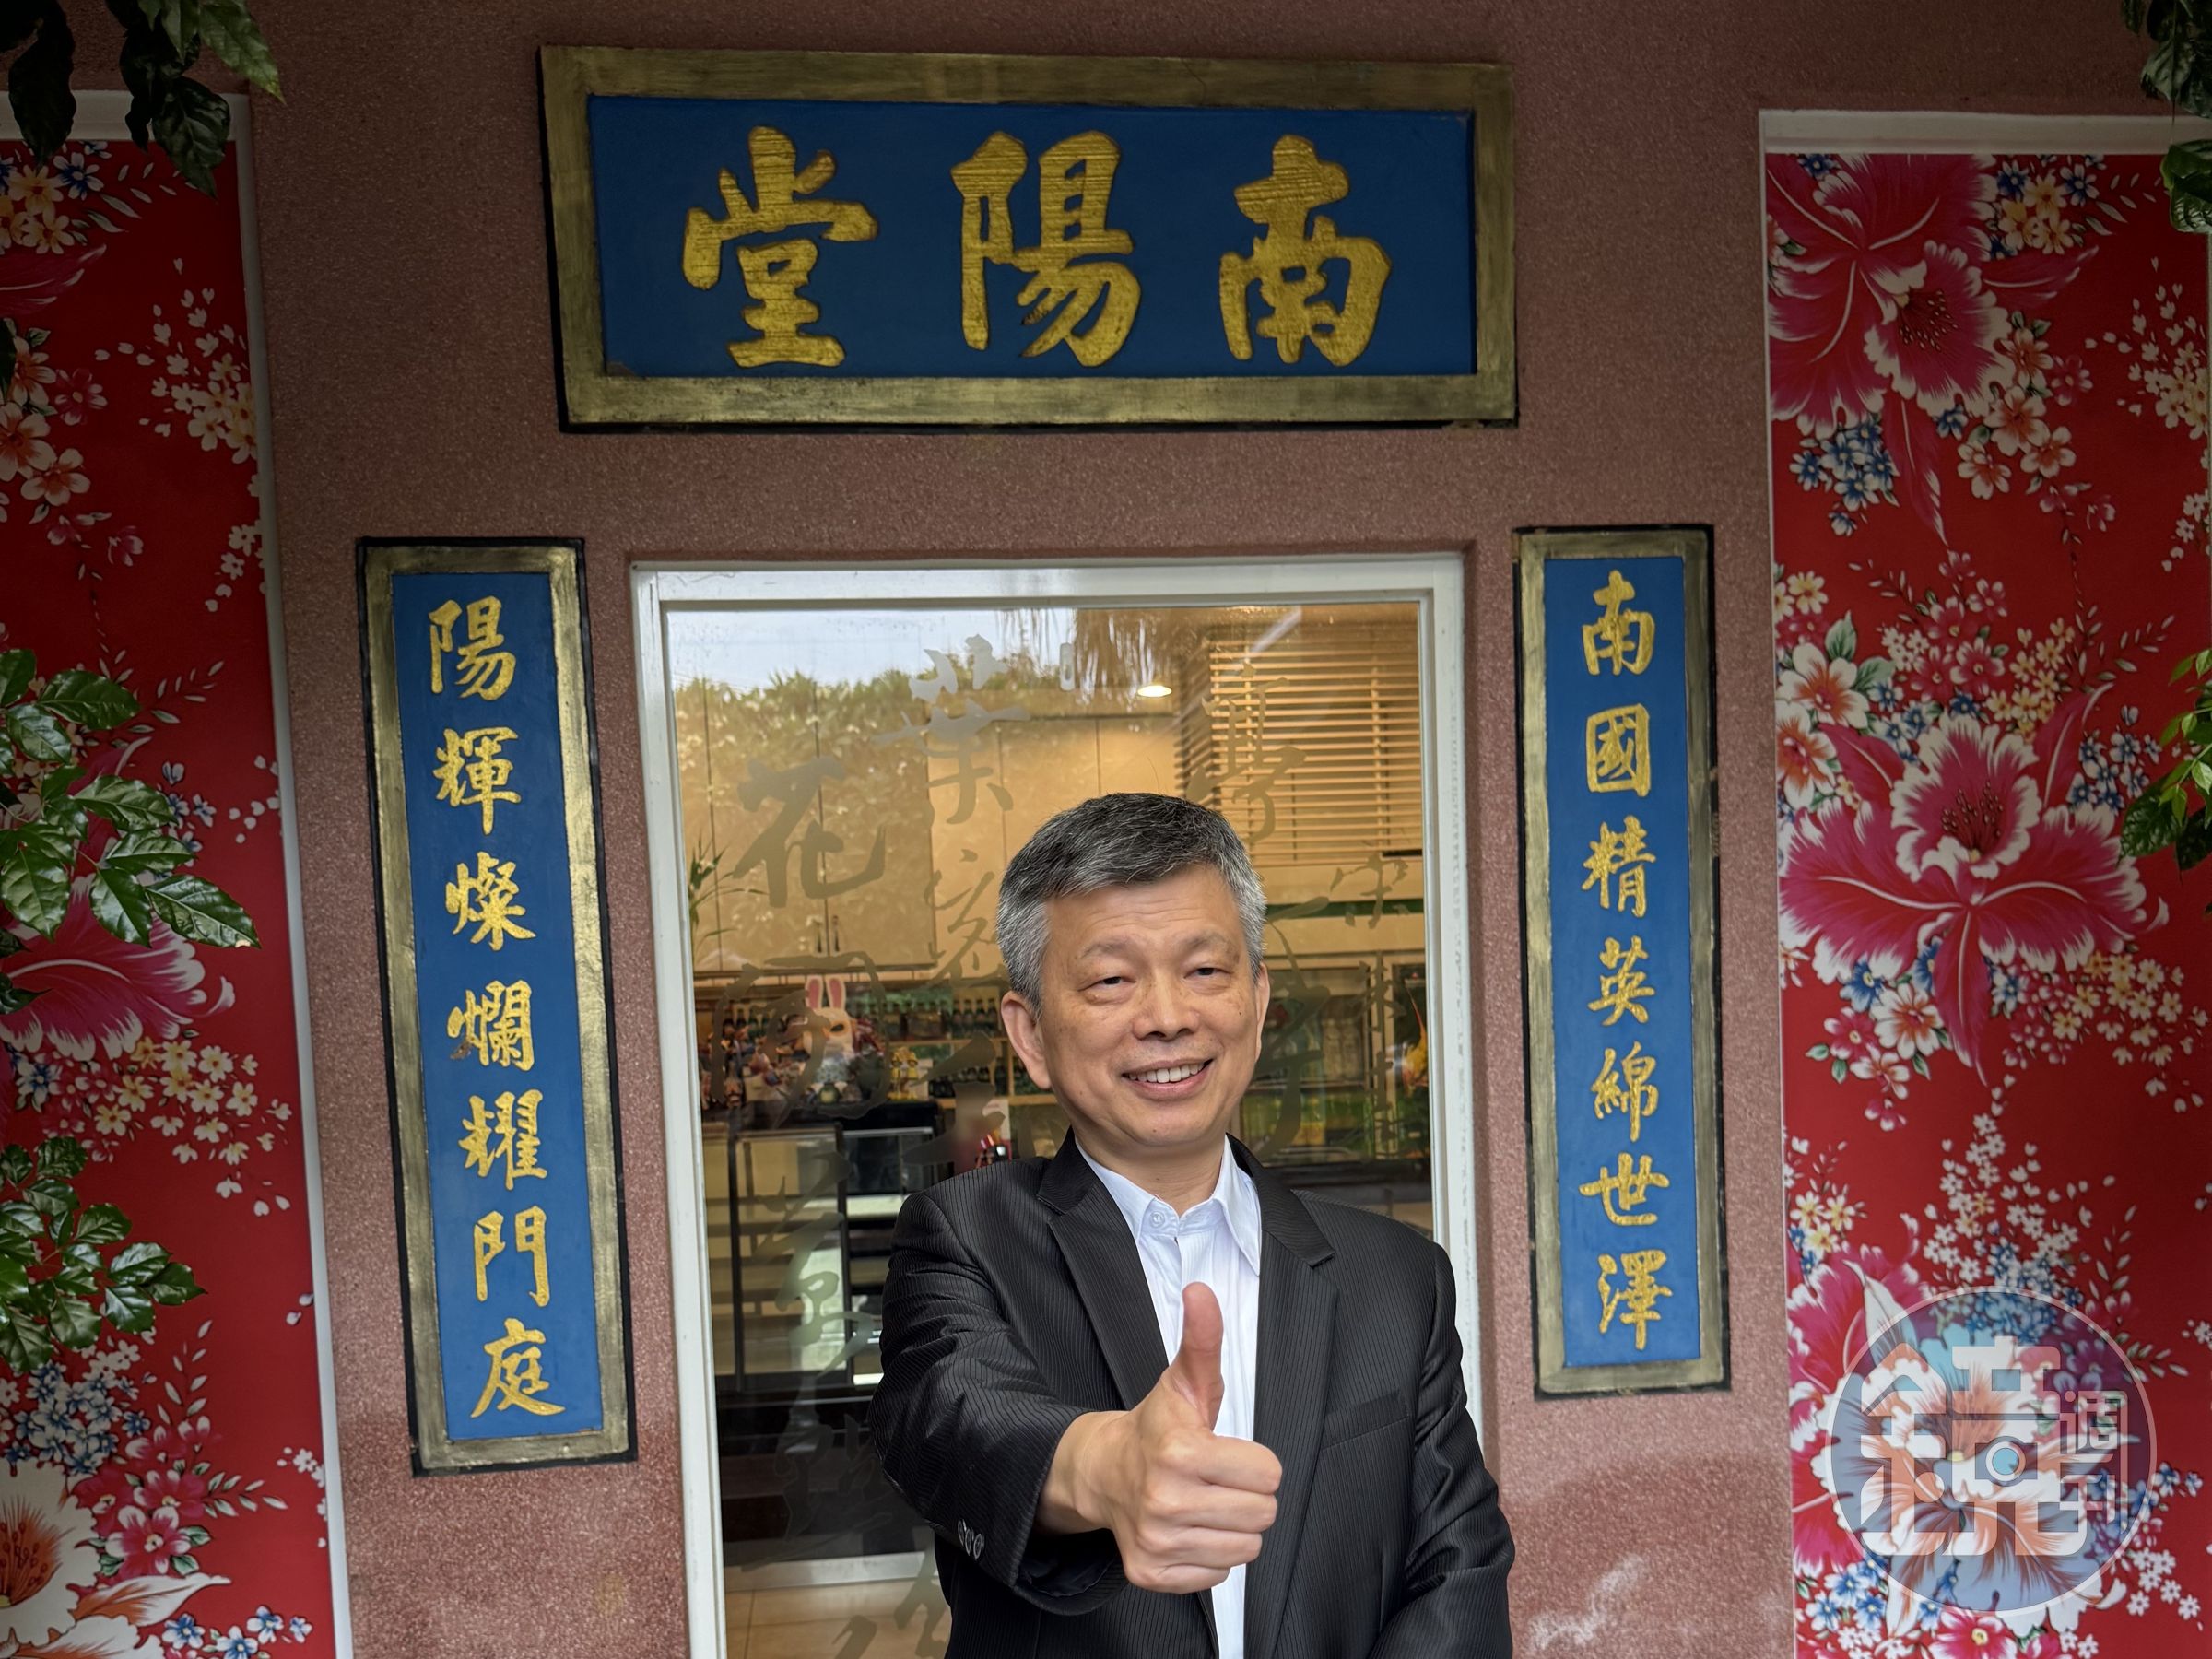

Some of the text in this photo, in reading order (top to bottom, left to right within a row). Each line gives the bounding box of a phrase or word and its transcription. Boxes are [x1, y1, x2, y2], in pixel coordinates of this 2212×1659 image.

[682, 125, 1392, 366] 南陽堂
[429, 595, 565, 1418] 陽輝燦爛耀門庭
[1579, 570, 1673, 1350] 南國精英綿世澤
